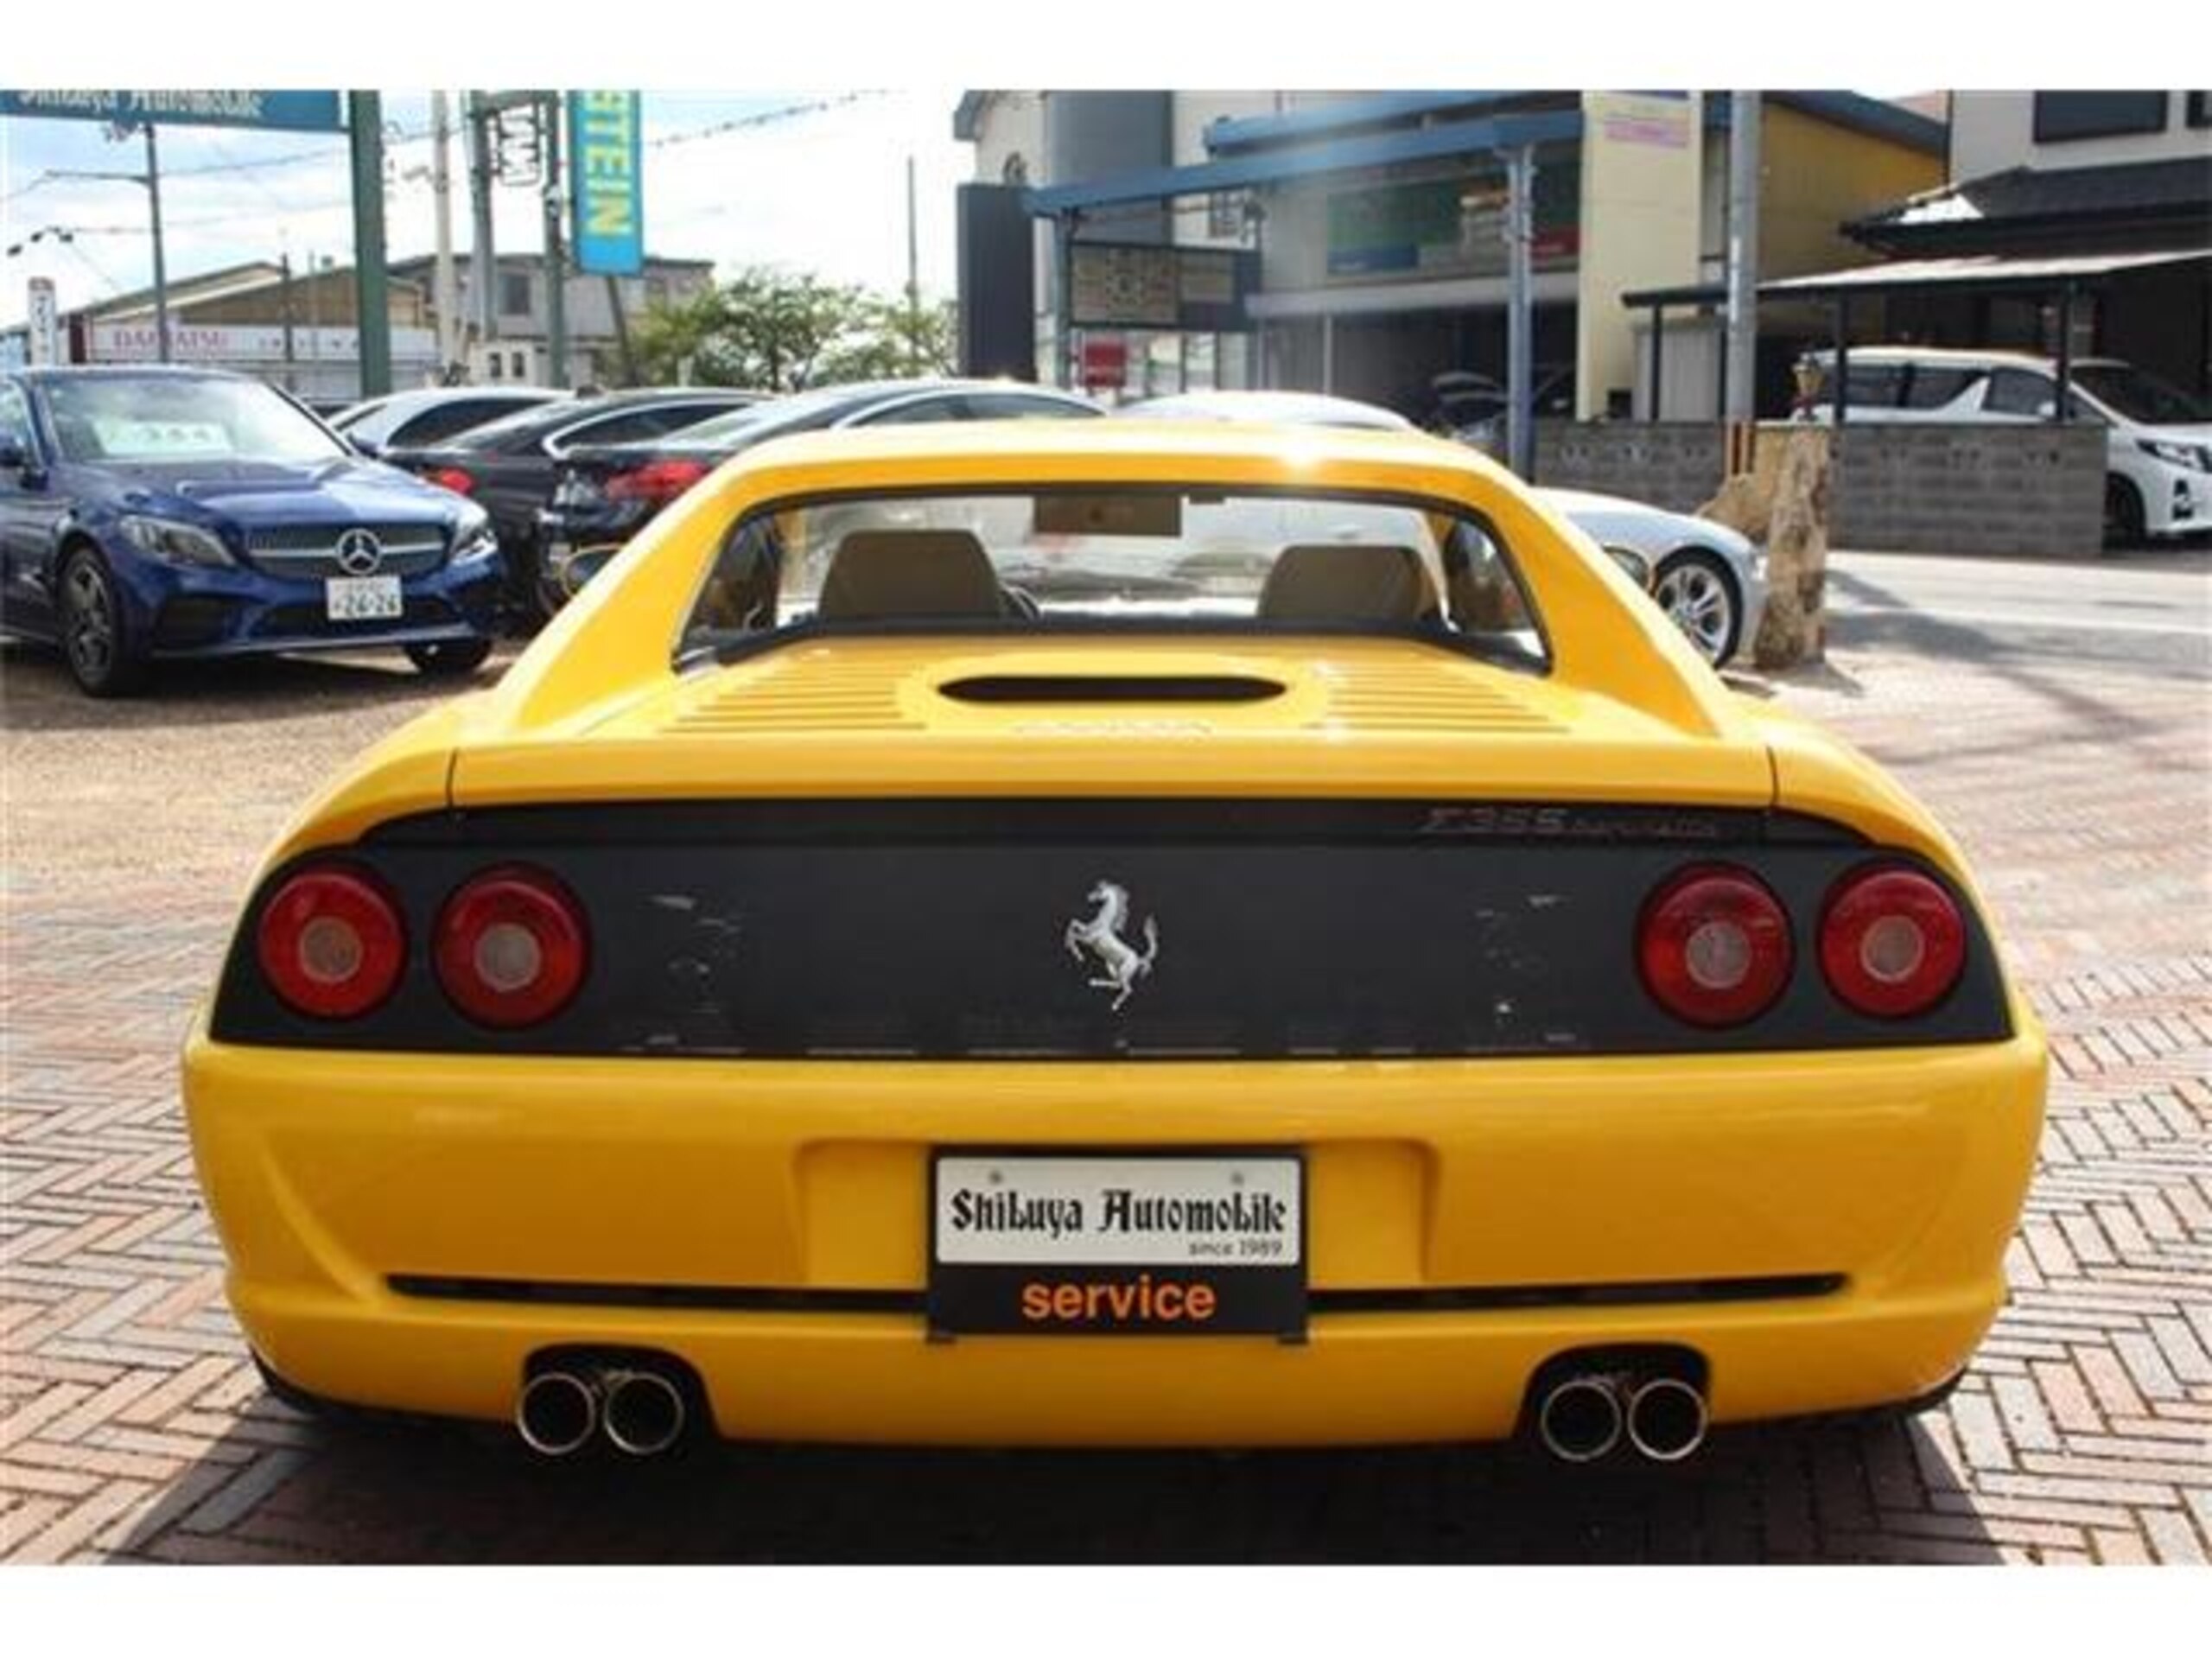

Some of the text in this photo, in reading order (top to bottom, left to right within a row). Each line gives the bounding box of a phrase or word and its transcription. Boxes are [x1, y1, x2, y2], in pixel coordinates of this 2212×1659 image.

[951, 1188, 1287, 1238] Shibuya Automobile
[1189, 1239, 1283, 1256] since 1989
[1021, 1274, 1216, 1319] service
